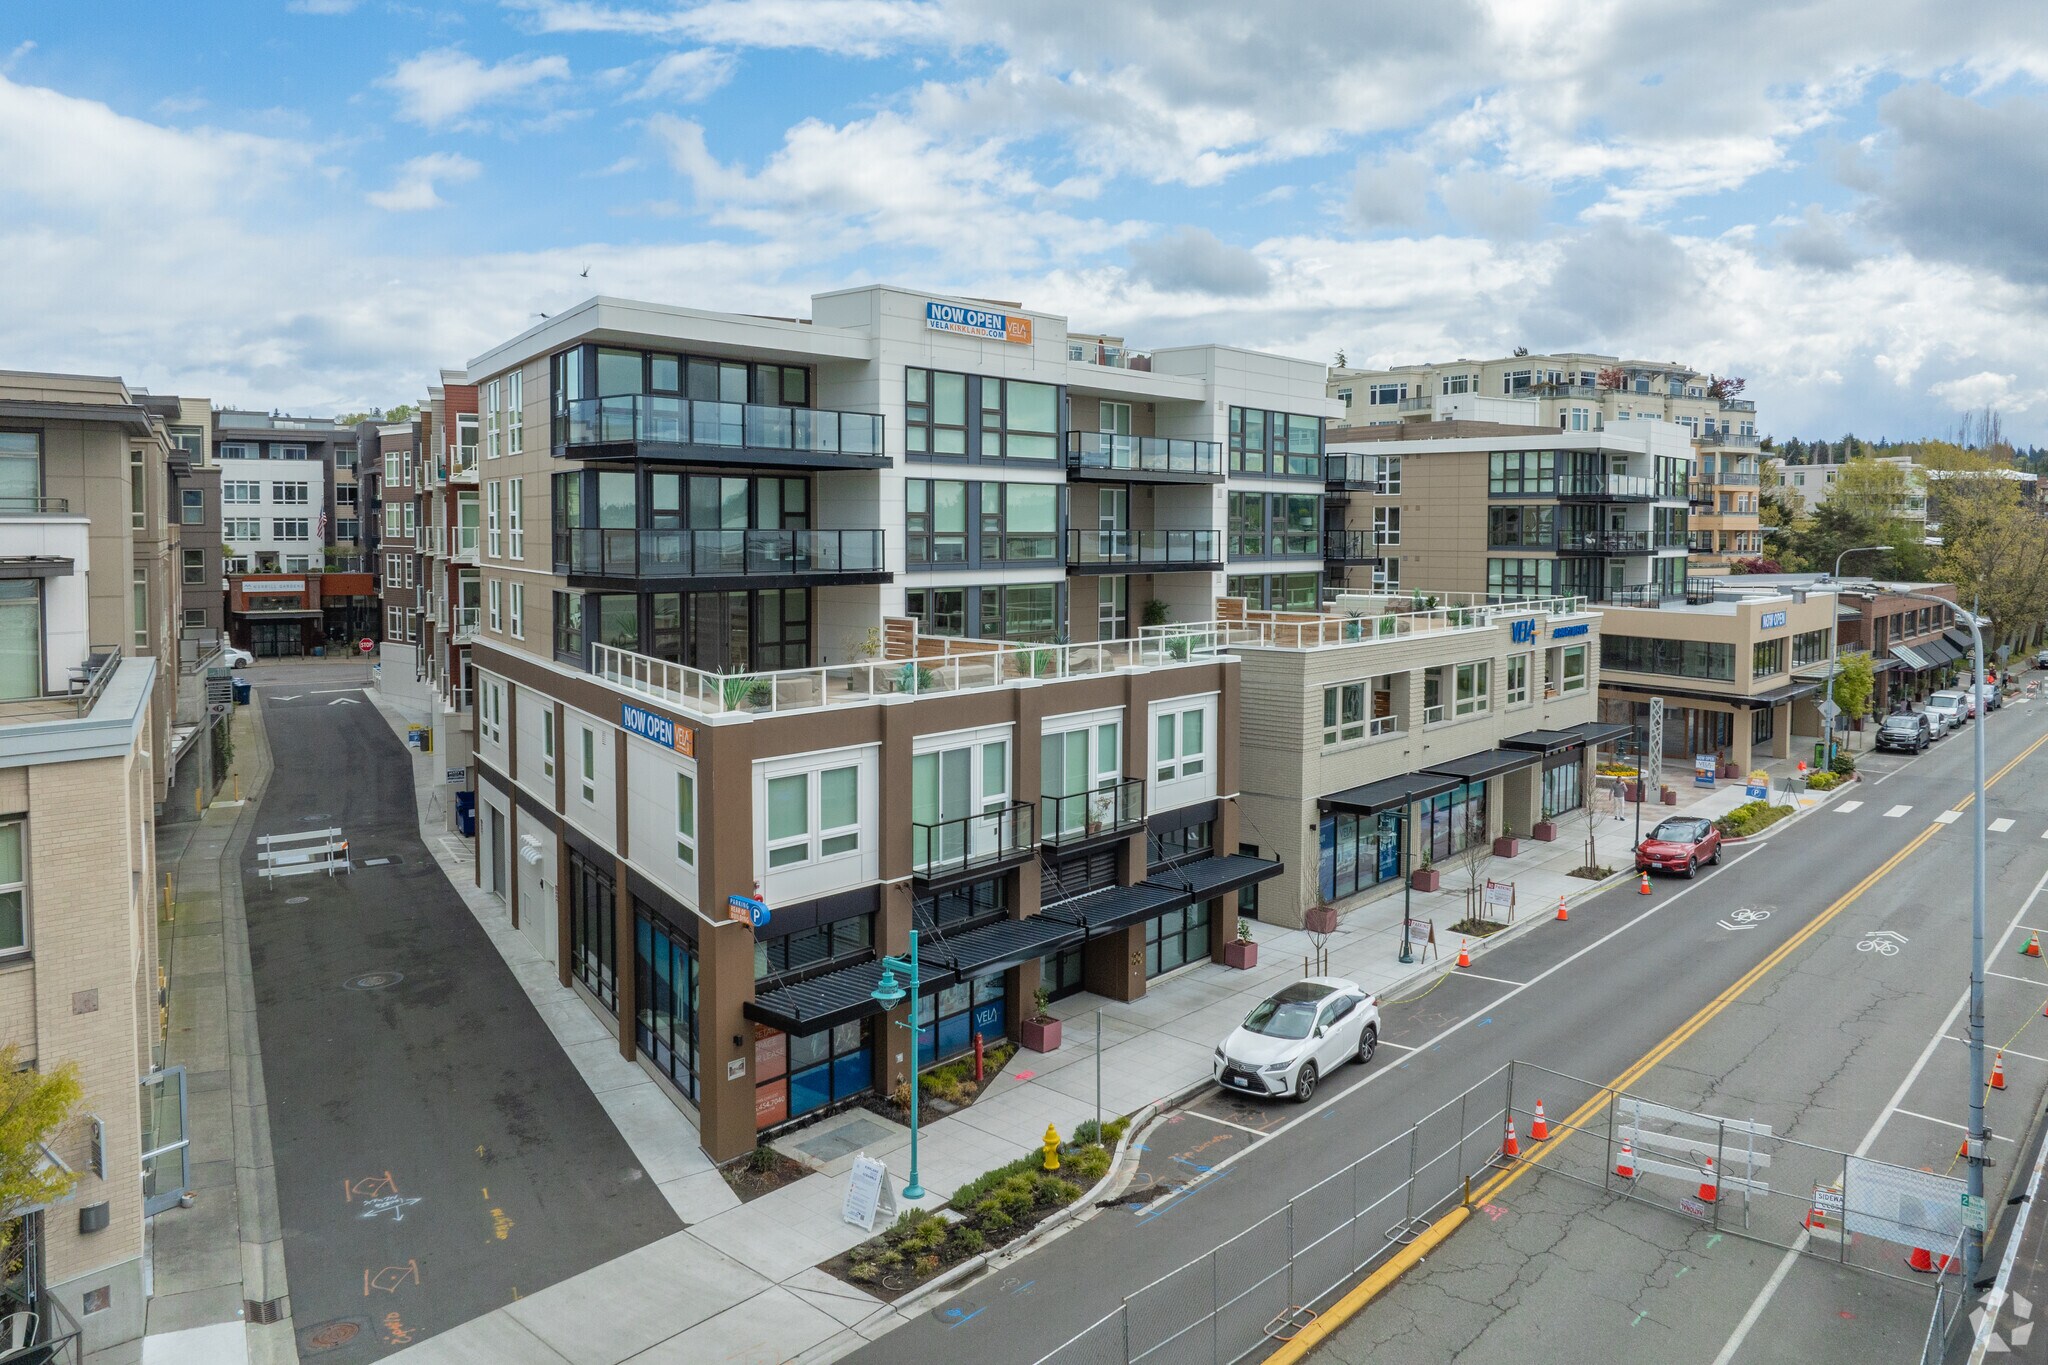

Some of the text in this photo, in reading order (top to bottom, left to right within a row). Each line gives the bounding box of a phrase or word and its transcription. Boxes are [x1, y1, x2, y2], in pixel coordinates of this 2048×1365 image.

[931, 304, 1002, 329] NOW OPEN
[930, 321, 1004, 339] VELAKIRKLAND.COM
[1006, 321, 1026, 336] VELA
[1762, 611, 1786, 628] NOW OPEN
[1512, 618, 1535, 645] VELA
[624, 706, 673, 745] NOW OPEN
[675, 726, 689, 748] VELA
[730, 898, 750, 910] PARKING
[753, 908, 761, 922] P
[976, 1007, 998, 1024] VELA
[1818, 1192, 1844, 1203] SIDEWA
[1962, 1196, 1968, 1205] 2
